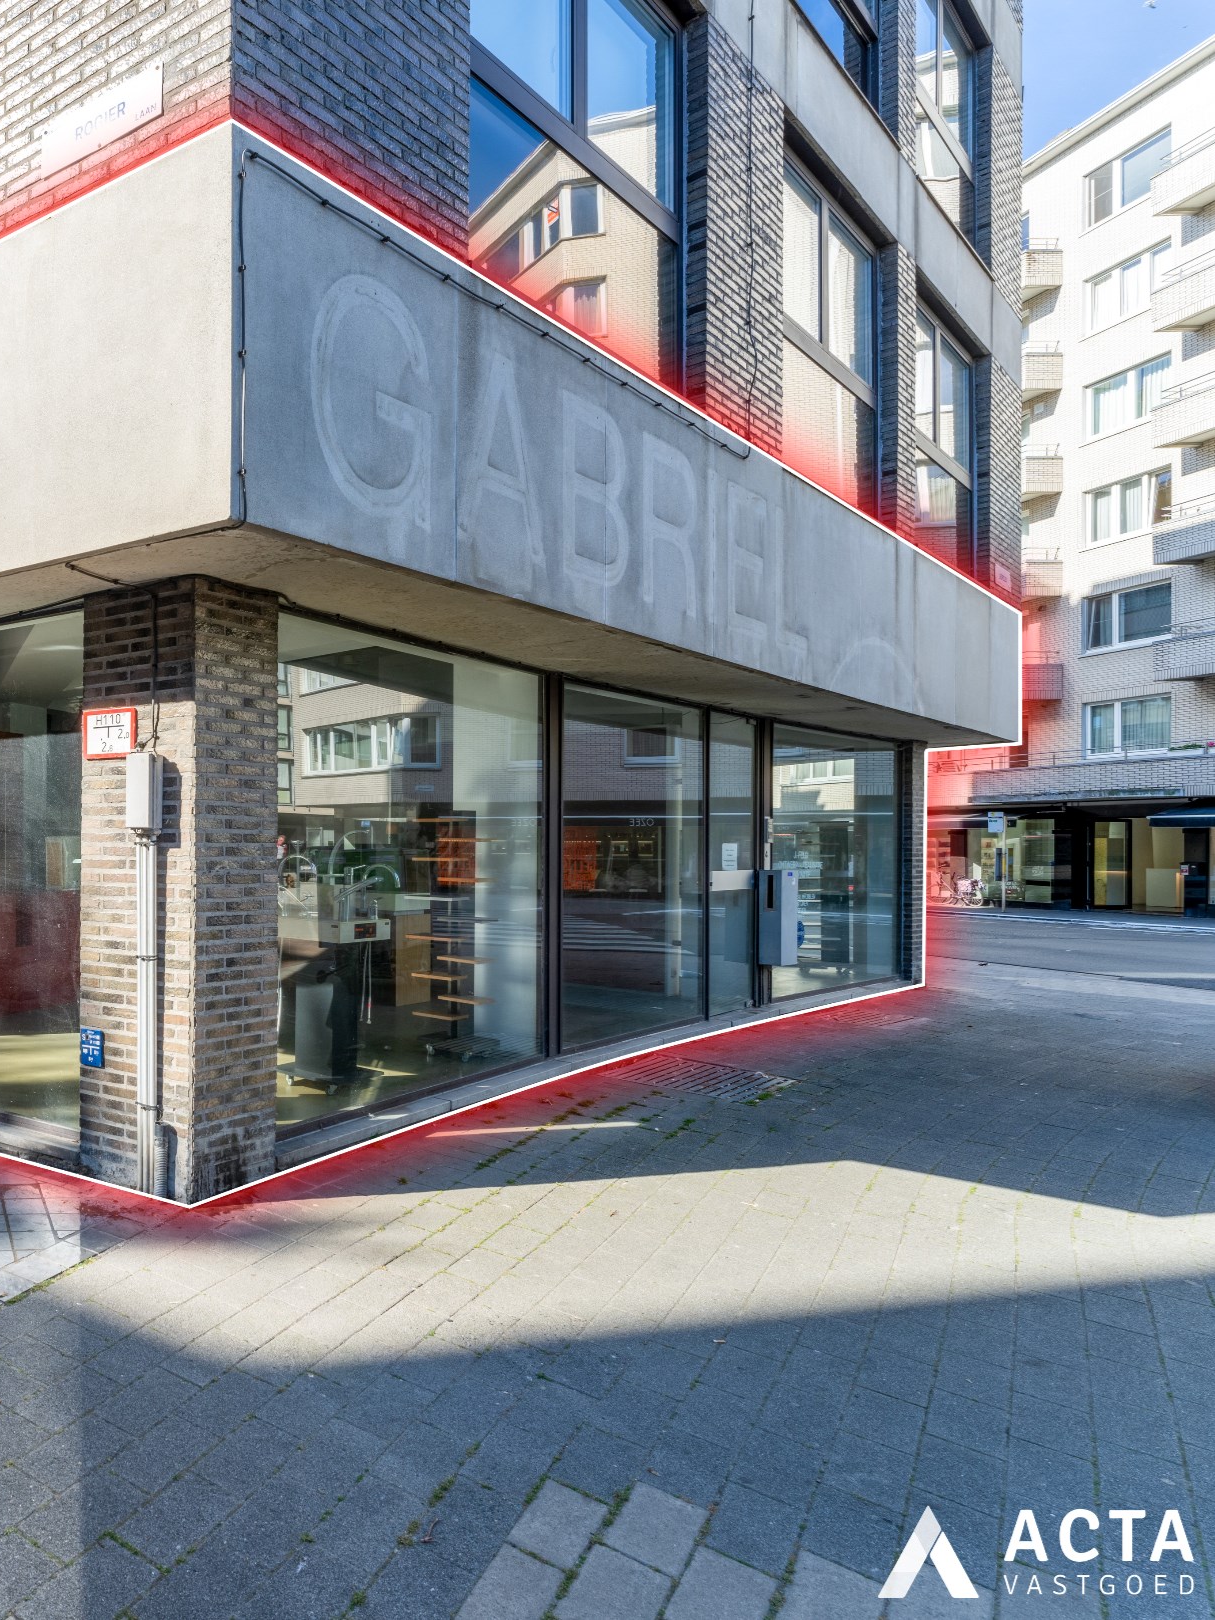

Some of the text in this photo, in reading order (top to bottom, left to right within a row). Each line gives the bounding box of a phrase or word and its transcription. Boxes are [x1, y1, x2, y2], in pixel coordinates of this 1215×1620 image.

[133, 102, 158, 121] LAAN
[310, 274, 809, 657] GABRIEL
[96, 713, 121, 726] H110
